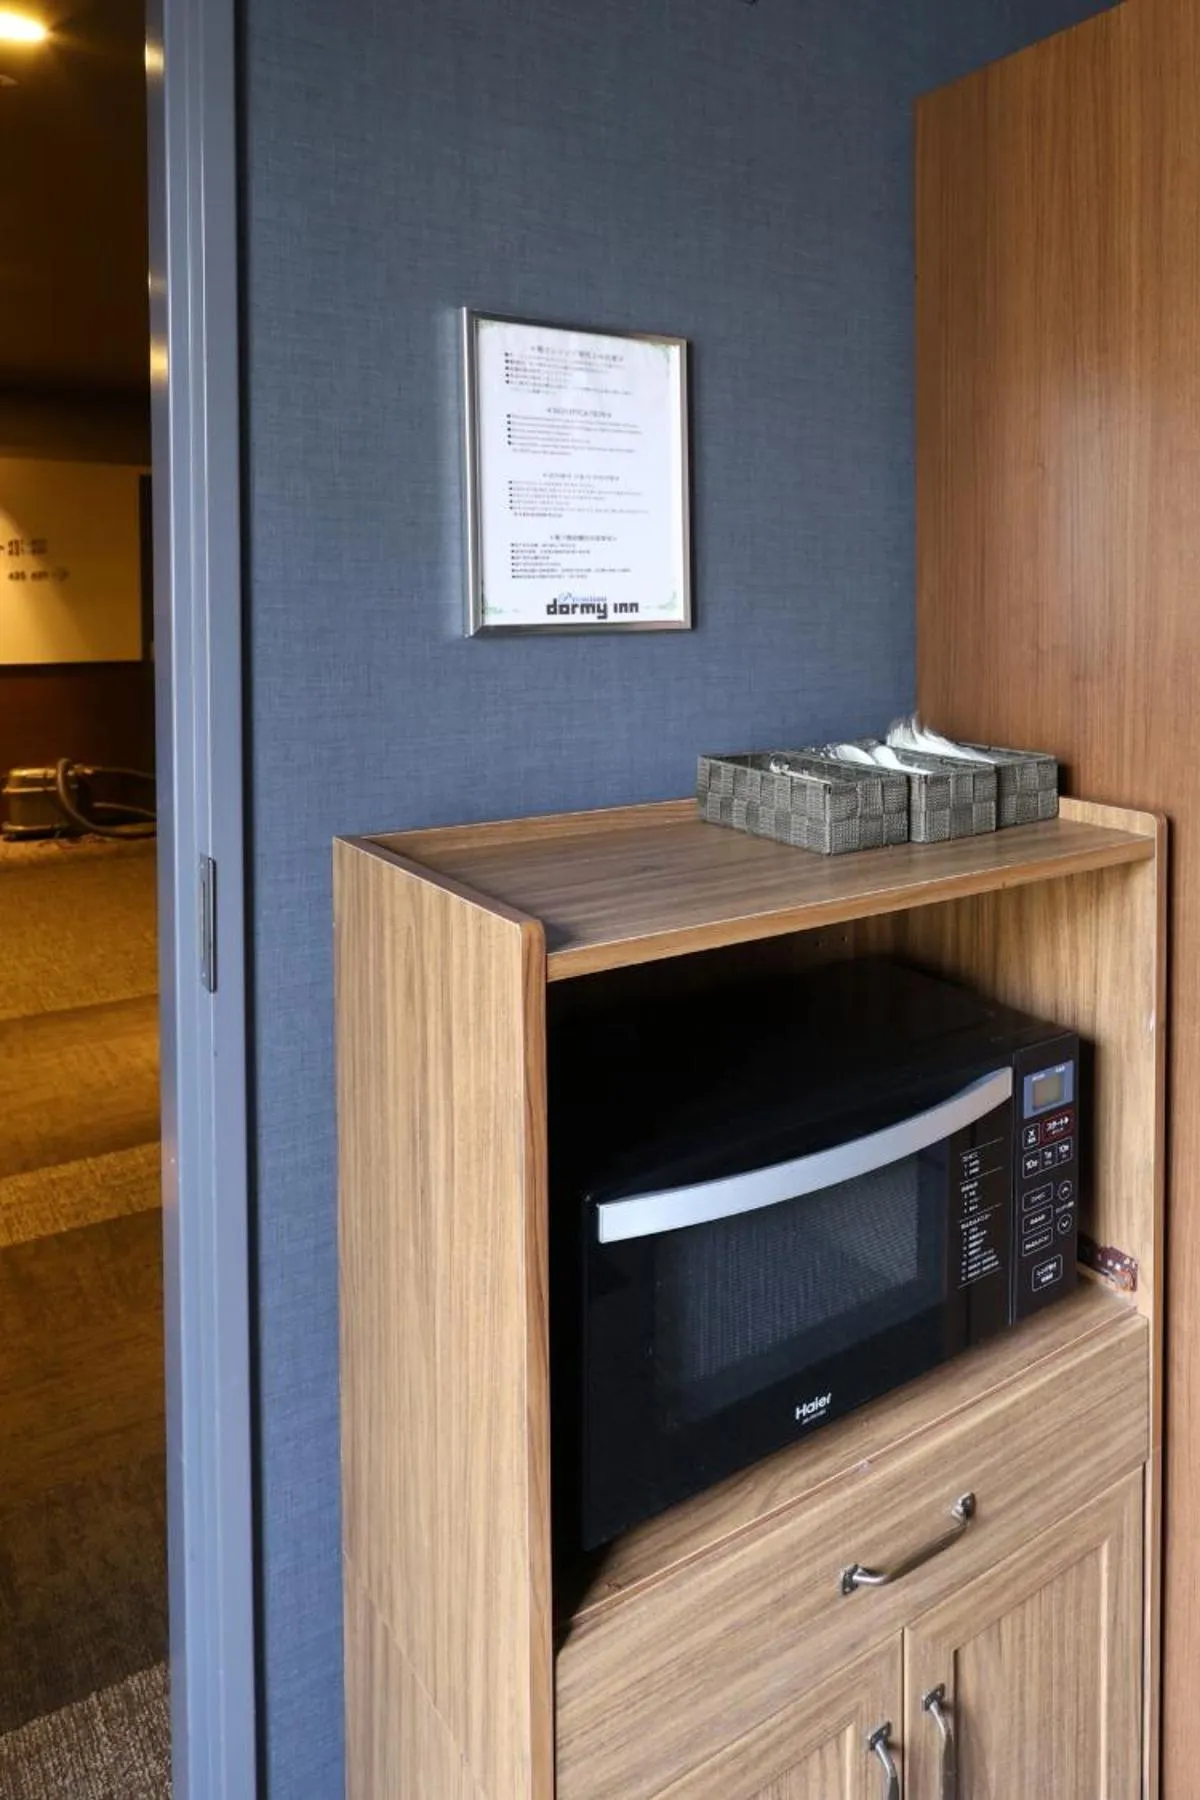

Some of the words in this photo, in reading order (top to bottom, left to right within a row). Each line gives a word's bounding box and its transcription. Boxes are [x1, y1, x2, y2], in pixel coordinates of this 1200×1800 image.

[546, 597, 608, 620] dormy
[613, 602, 640, 614] inn
[795, 1391, 832, 1420] Haier
